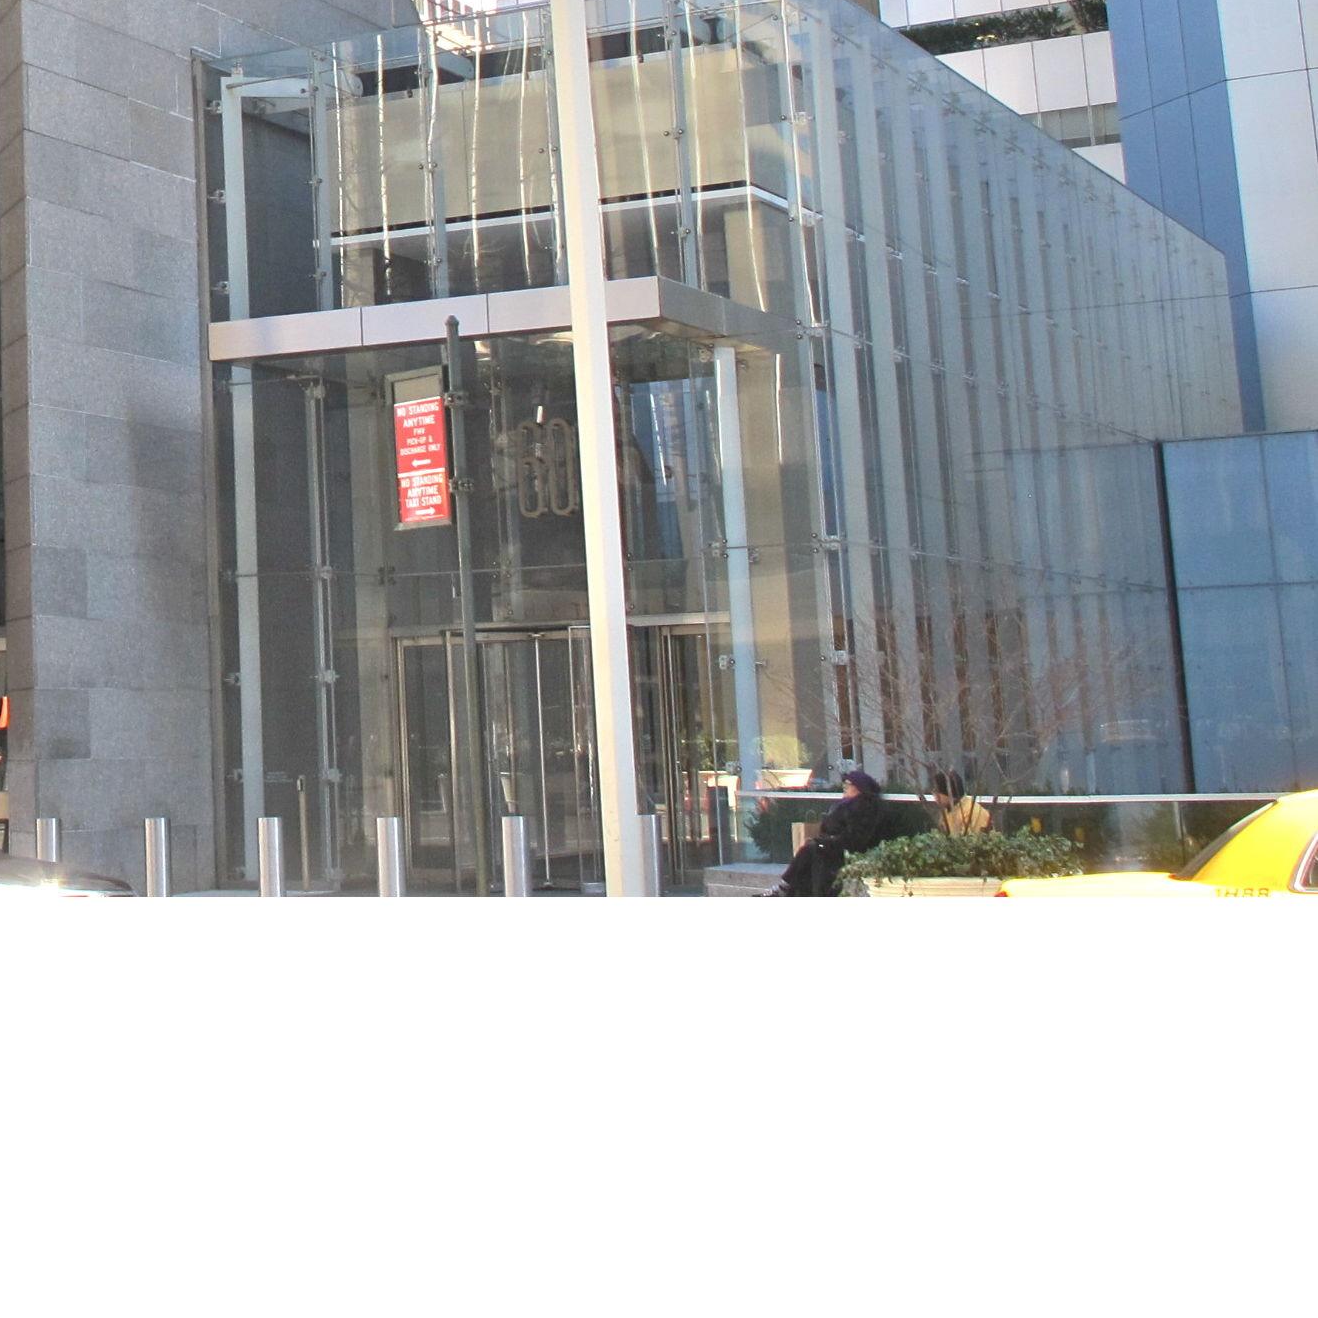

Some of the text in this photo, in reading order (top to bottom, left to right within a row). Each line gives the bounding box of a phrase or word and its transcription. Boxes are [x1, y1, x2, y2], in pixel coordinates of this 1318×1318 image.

[397, 402, 439, 417] NO STANDING
[403, 415, 435, 428] ANYTIME
[401, 474, 443, 488] NO STANDING
[407, 485, 439, 498] ANYTIME
[405, 495, 442, 508] TAXI STAND
